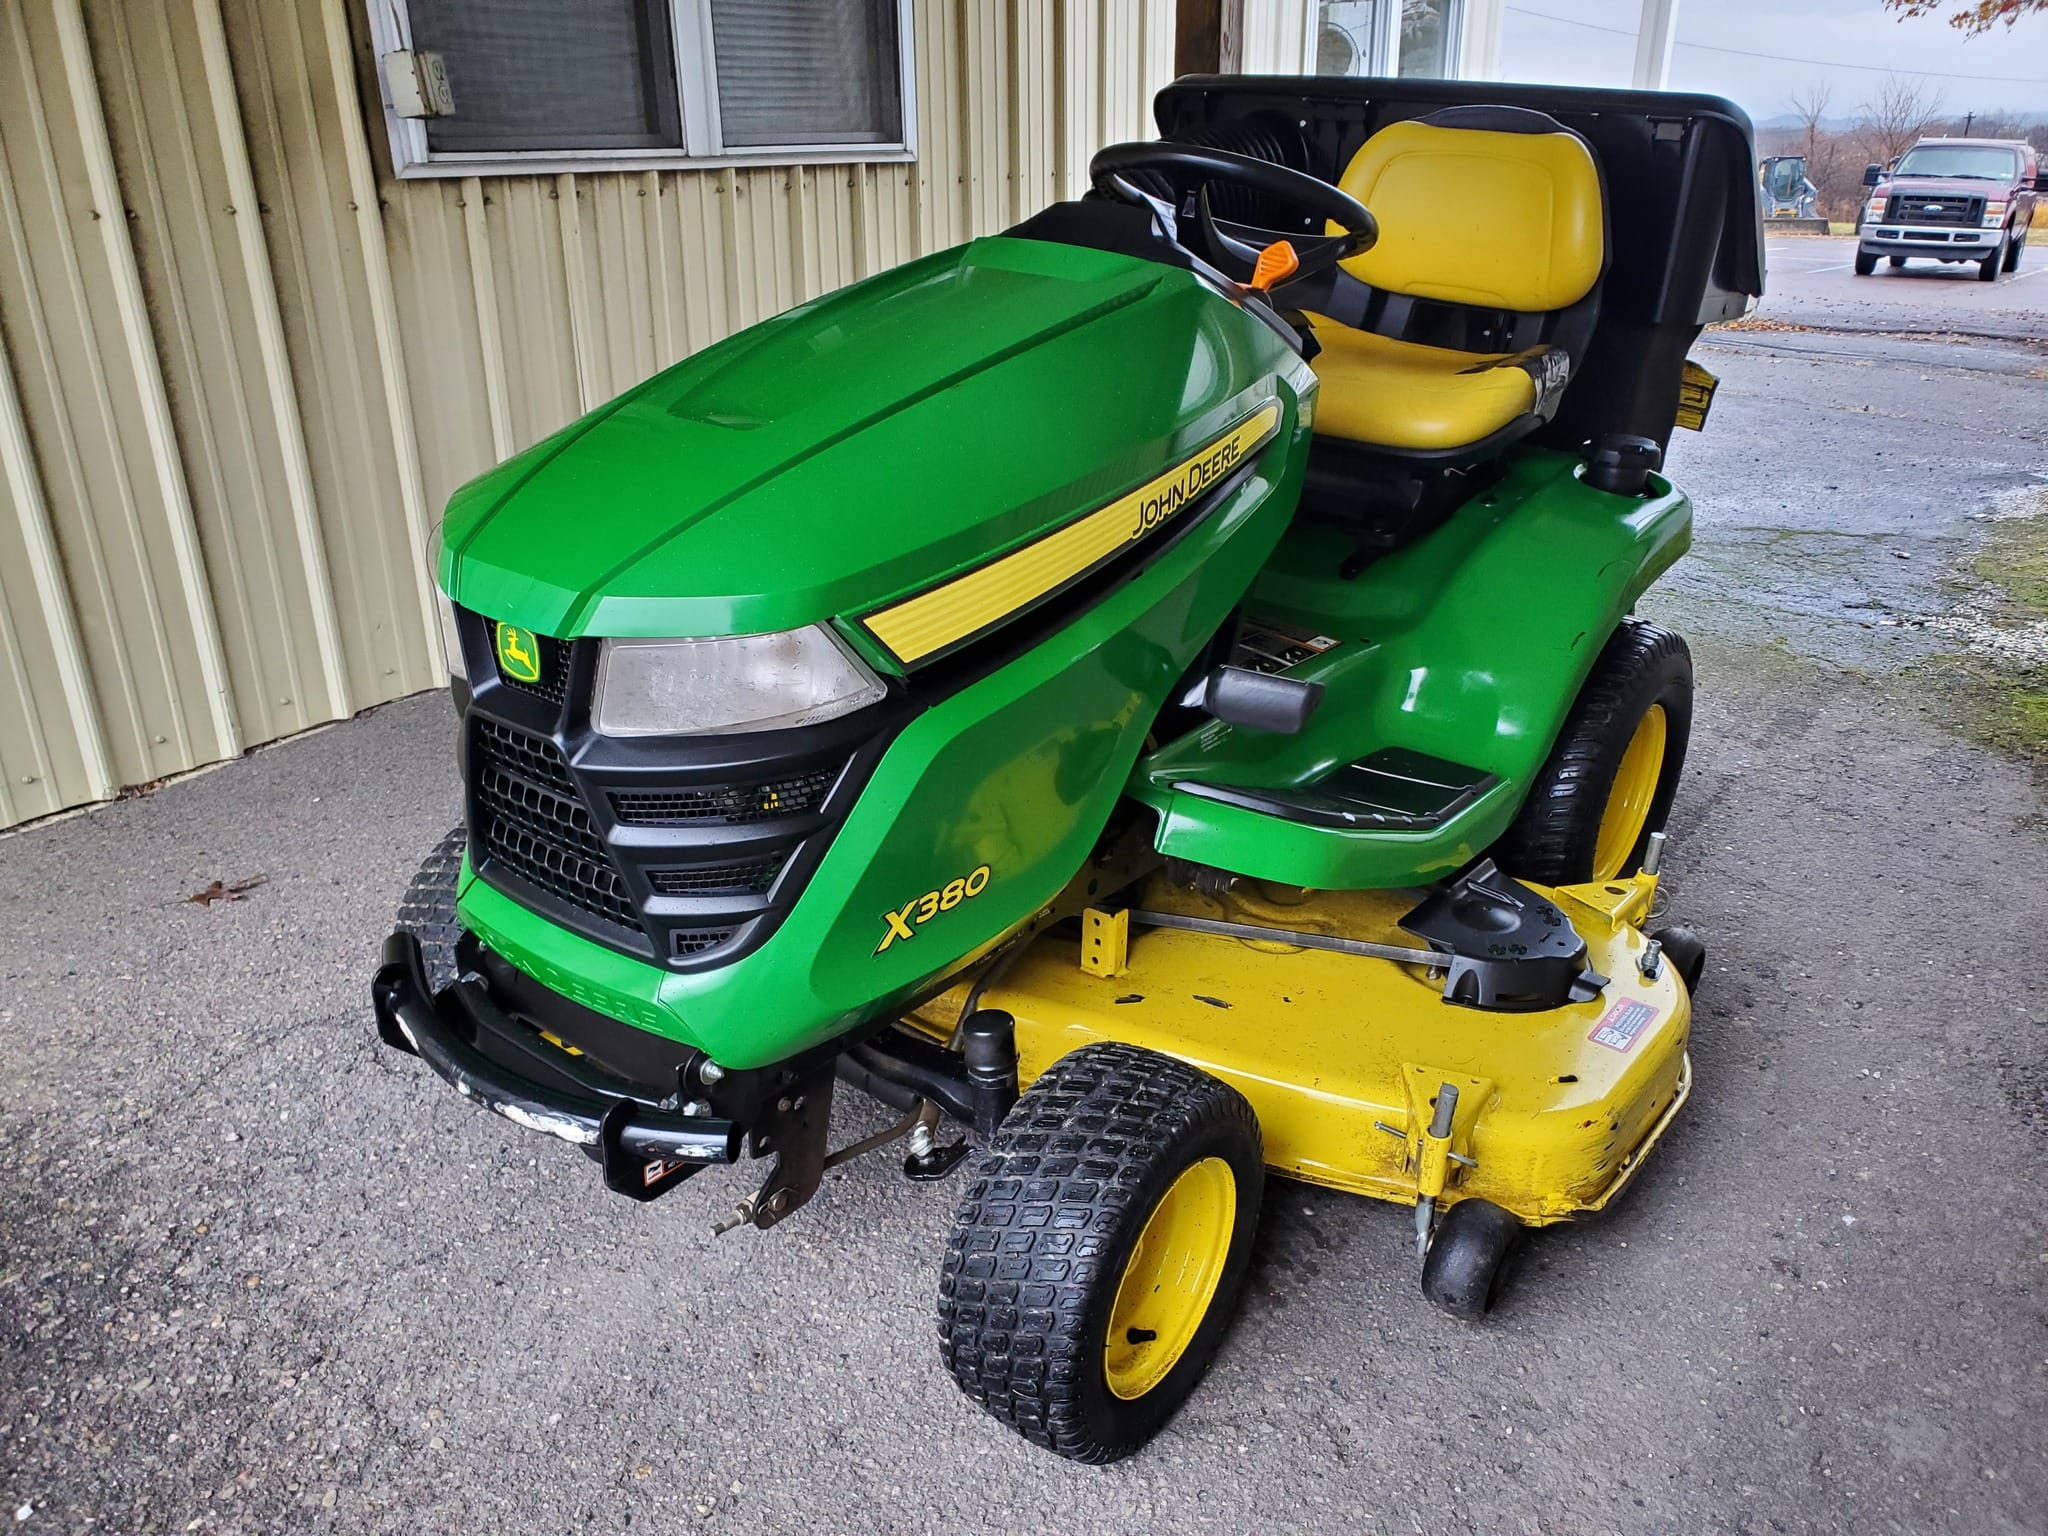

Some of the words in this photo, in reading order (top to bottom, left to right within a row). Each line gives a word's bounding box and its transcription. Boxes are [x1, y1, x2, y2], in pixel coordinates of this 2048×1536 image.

[1132, 478, 1186, 538] JOHN
[1187, 434, 1241, 498] DEERE
[872, 865, 991, 956] X380
